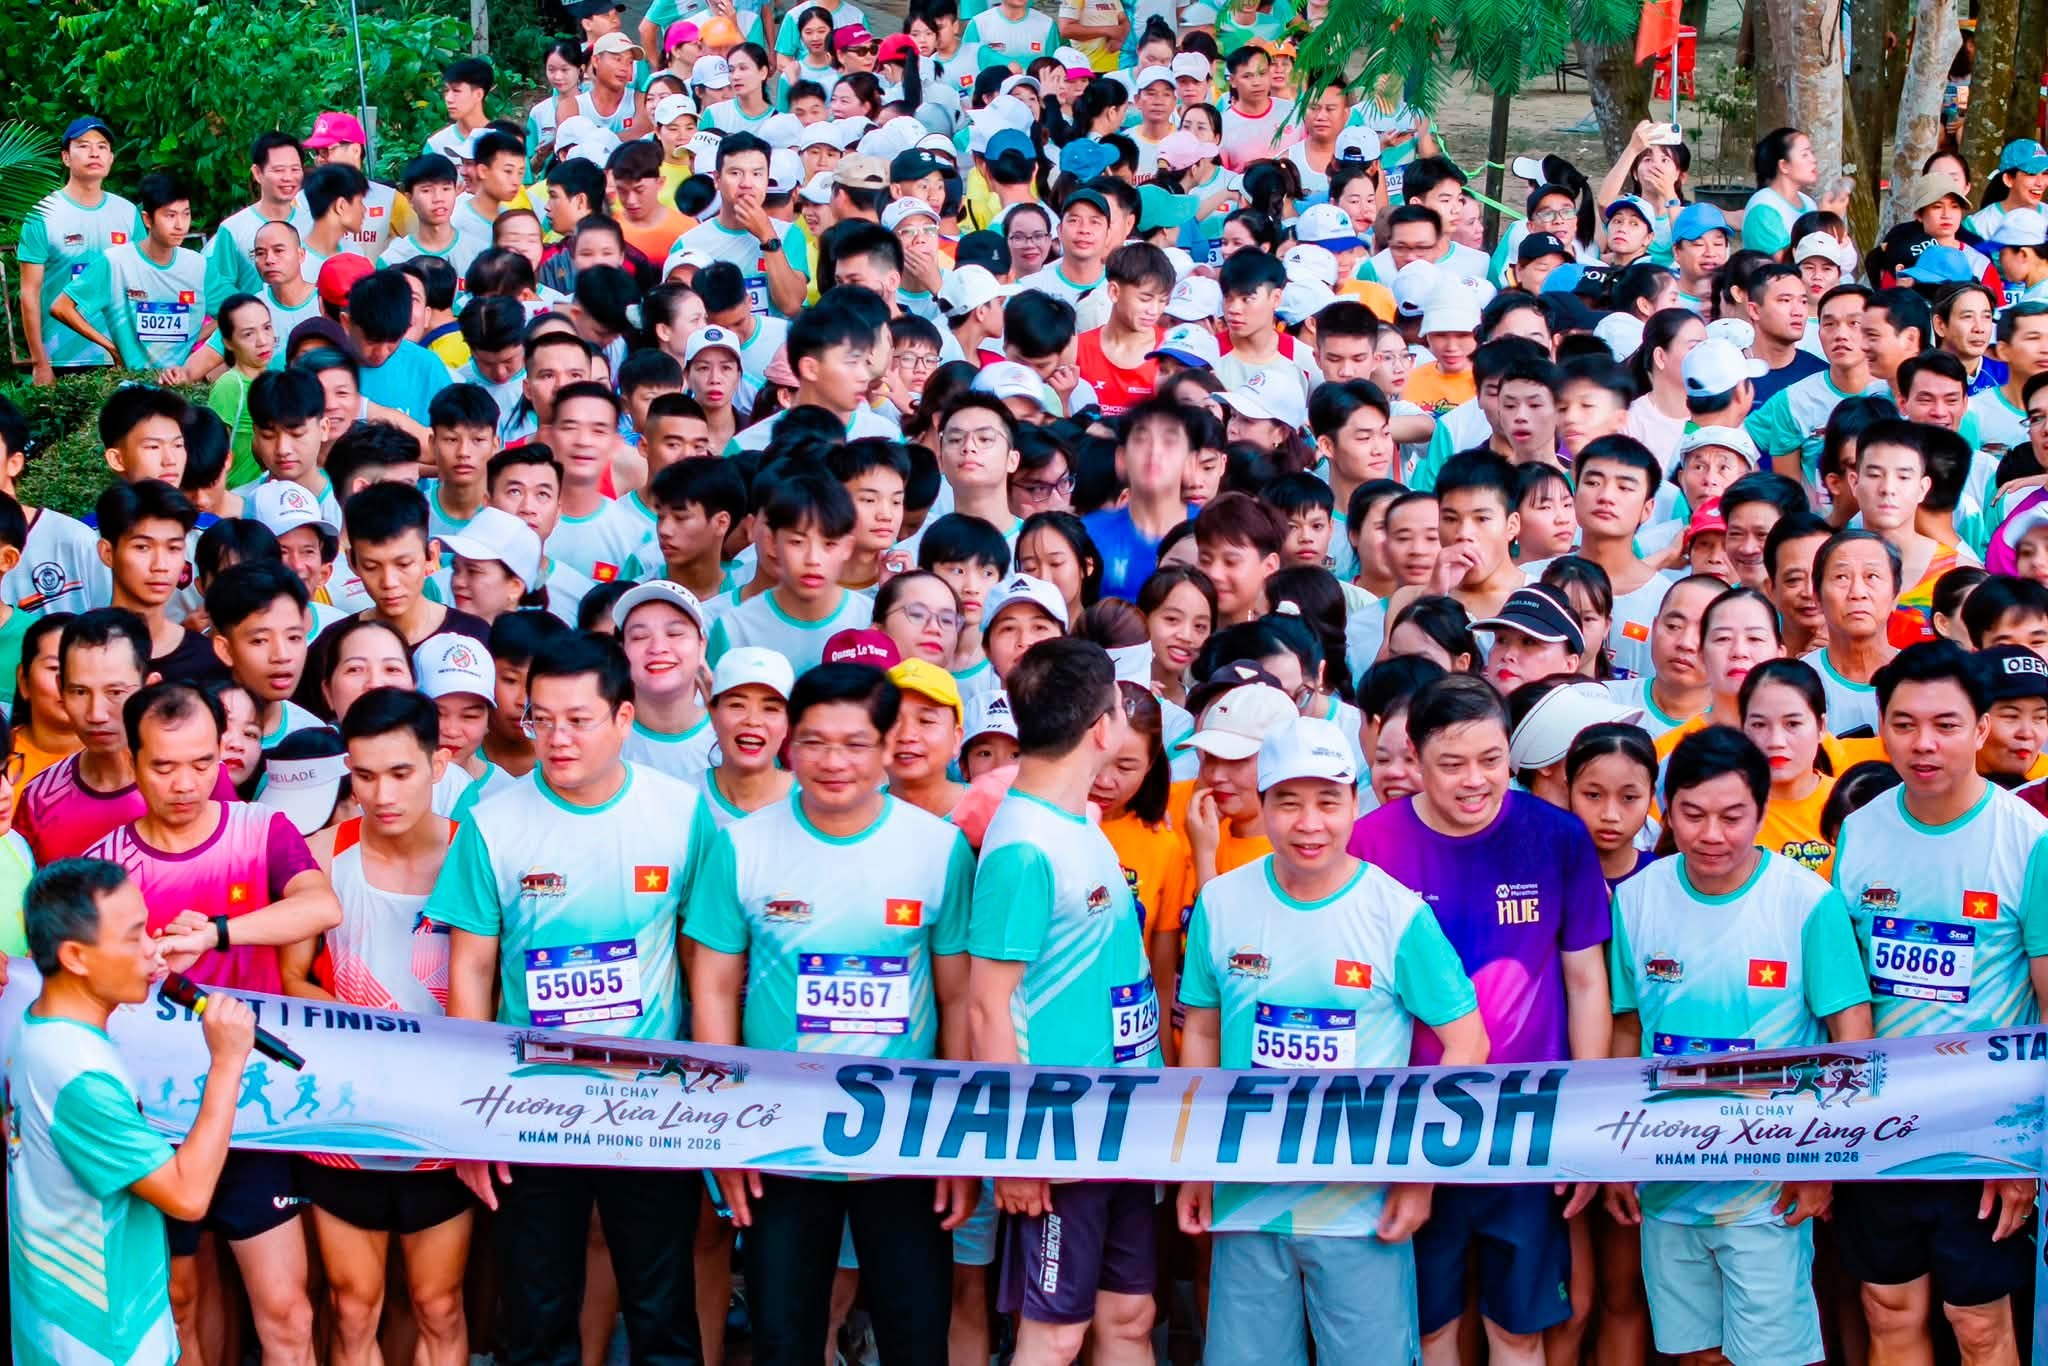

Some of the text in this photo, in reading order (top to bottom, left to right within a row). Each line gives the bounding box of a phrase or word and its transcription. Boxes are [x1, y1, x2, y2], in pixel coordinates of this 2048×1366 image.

[141, 315, 182, 329] 50274
[1875, 942, 1956, 977] 56868
[536, 967, 623, 1001] 55055
[807, 980, 892, 1008] 54567
[156, 990, 421, 1034] STT FINISH
[1257, 1029, 1338, 1062] 55555
[1987, 1031, 2048, 1062] STA
[585, 1083, 660, 1101] GIẢI CHẠY
[461, 1083, 784, 1135] Hương Xưa Làng Cổ
[822, 1063, 1569, 1168] START FINISH
[1719, 1102, 1795, 1119] GIẢI CHẠY
[518, 1128, 722, 1152] KHÁM PHÁ PHONG DINH 2026
[1594, 1108, 1921, 1154] Hương Xưa Làng Cổ
[1655, 1149, 1859, 1166] KHÁM PHÁ PHONG DINH 2026
[1046, 1214, 1061, 1260] adidas
